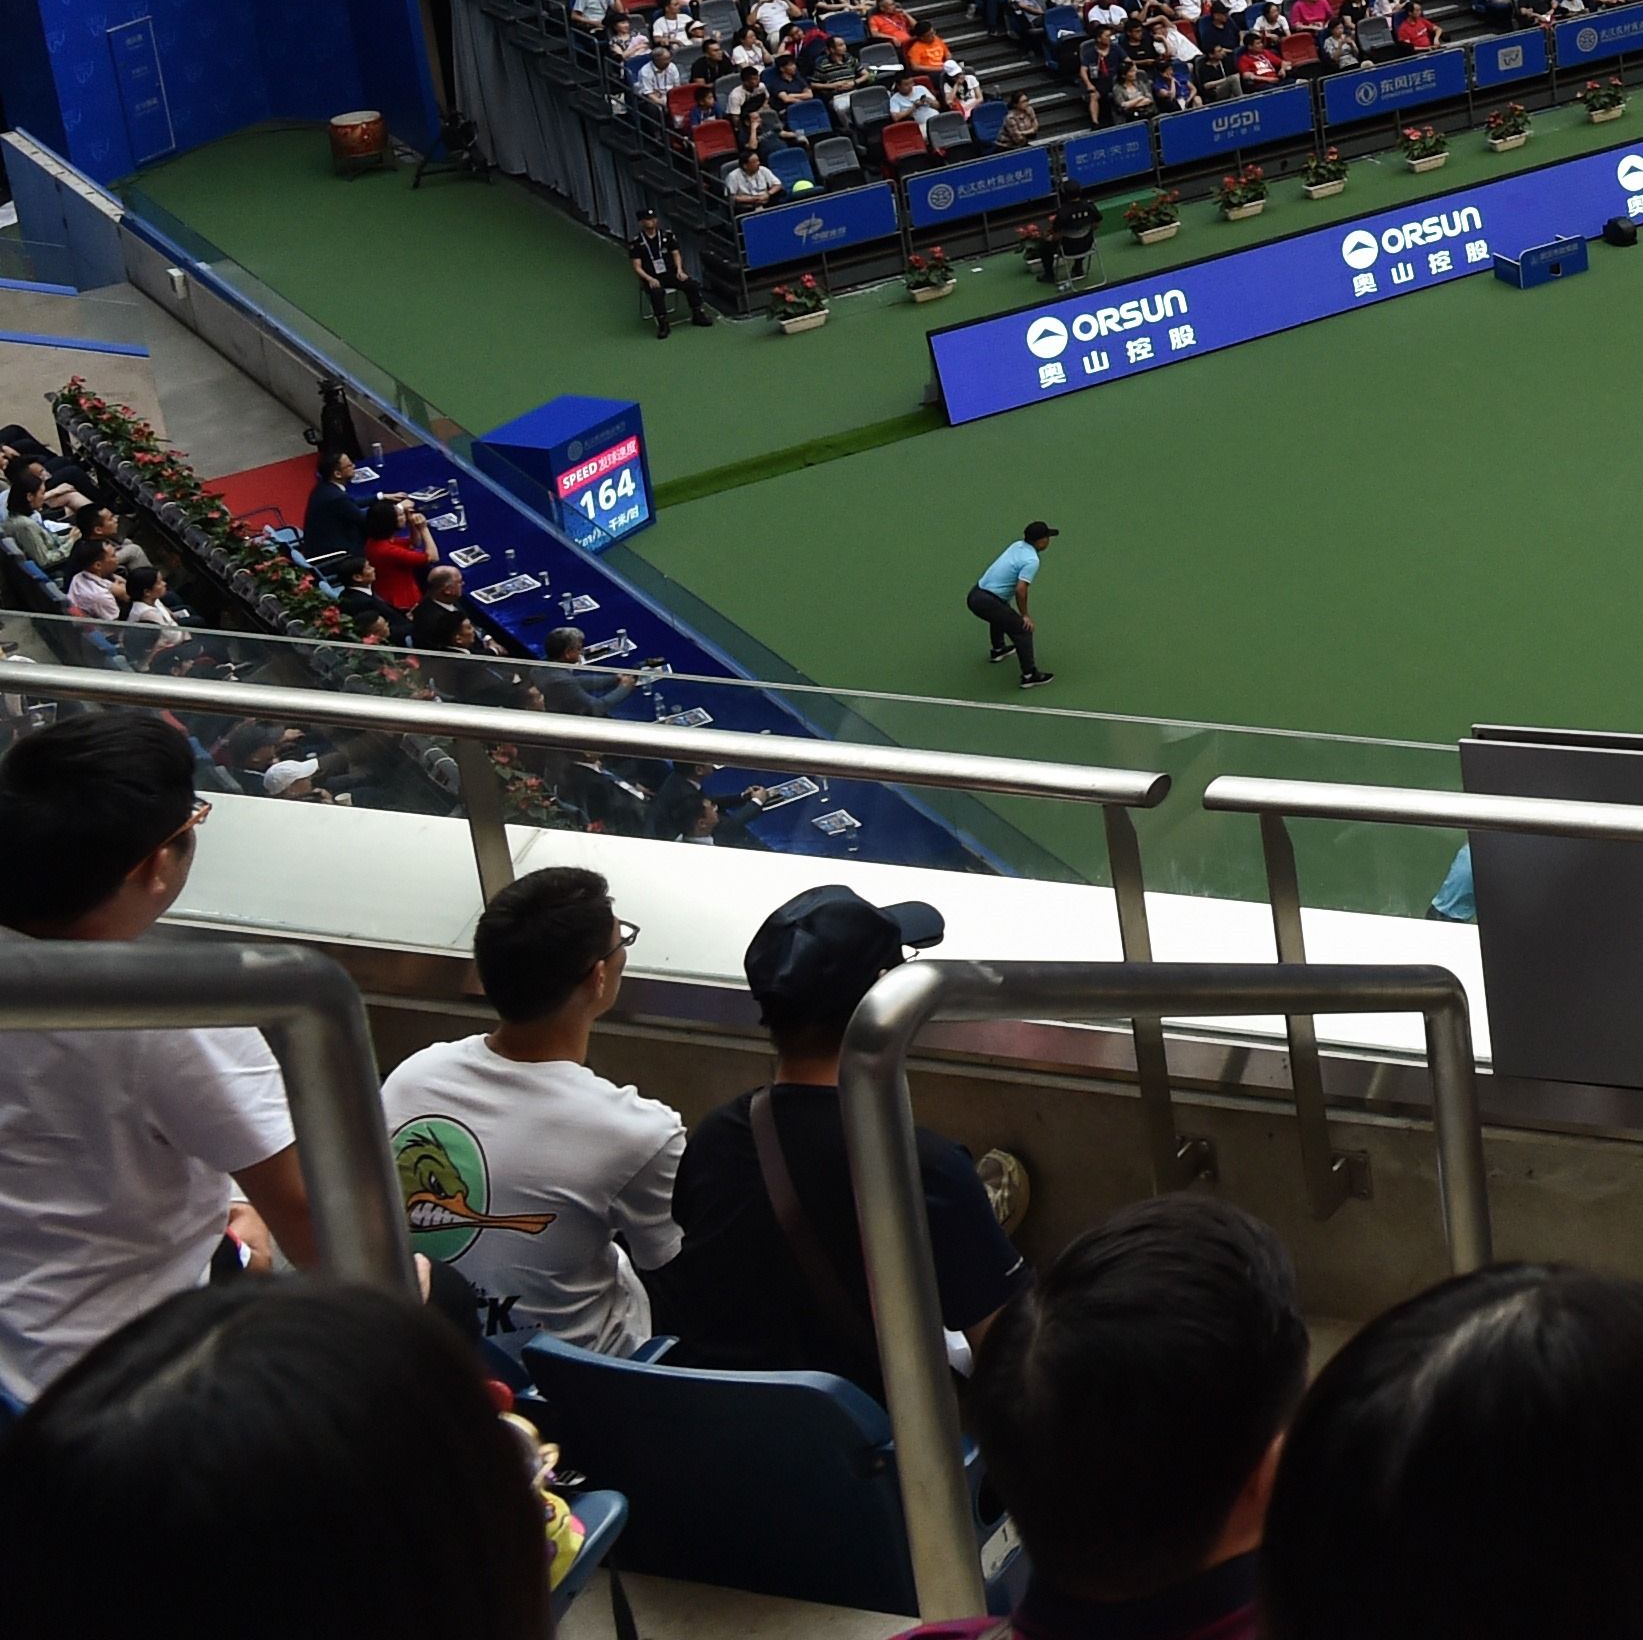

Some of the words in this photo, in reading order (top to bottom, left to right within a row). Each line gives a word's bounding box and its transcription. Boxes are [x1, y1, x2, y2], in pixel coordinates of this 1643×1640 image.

[1381, 205, 1482, 253] ORSUN
[1353, 239, 1490, 297] 奥山控股
[1072, 289, 1187, 340] ORSUN
[1038, 324, 1196, 388] 奥山控股
[562, 461, 598, 490] SPEED
[579, 467, 636, 521] 164
